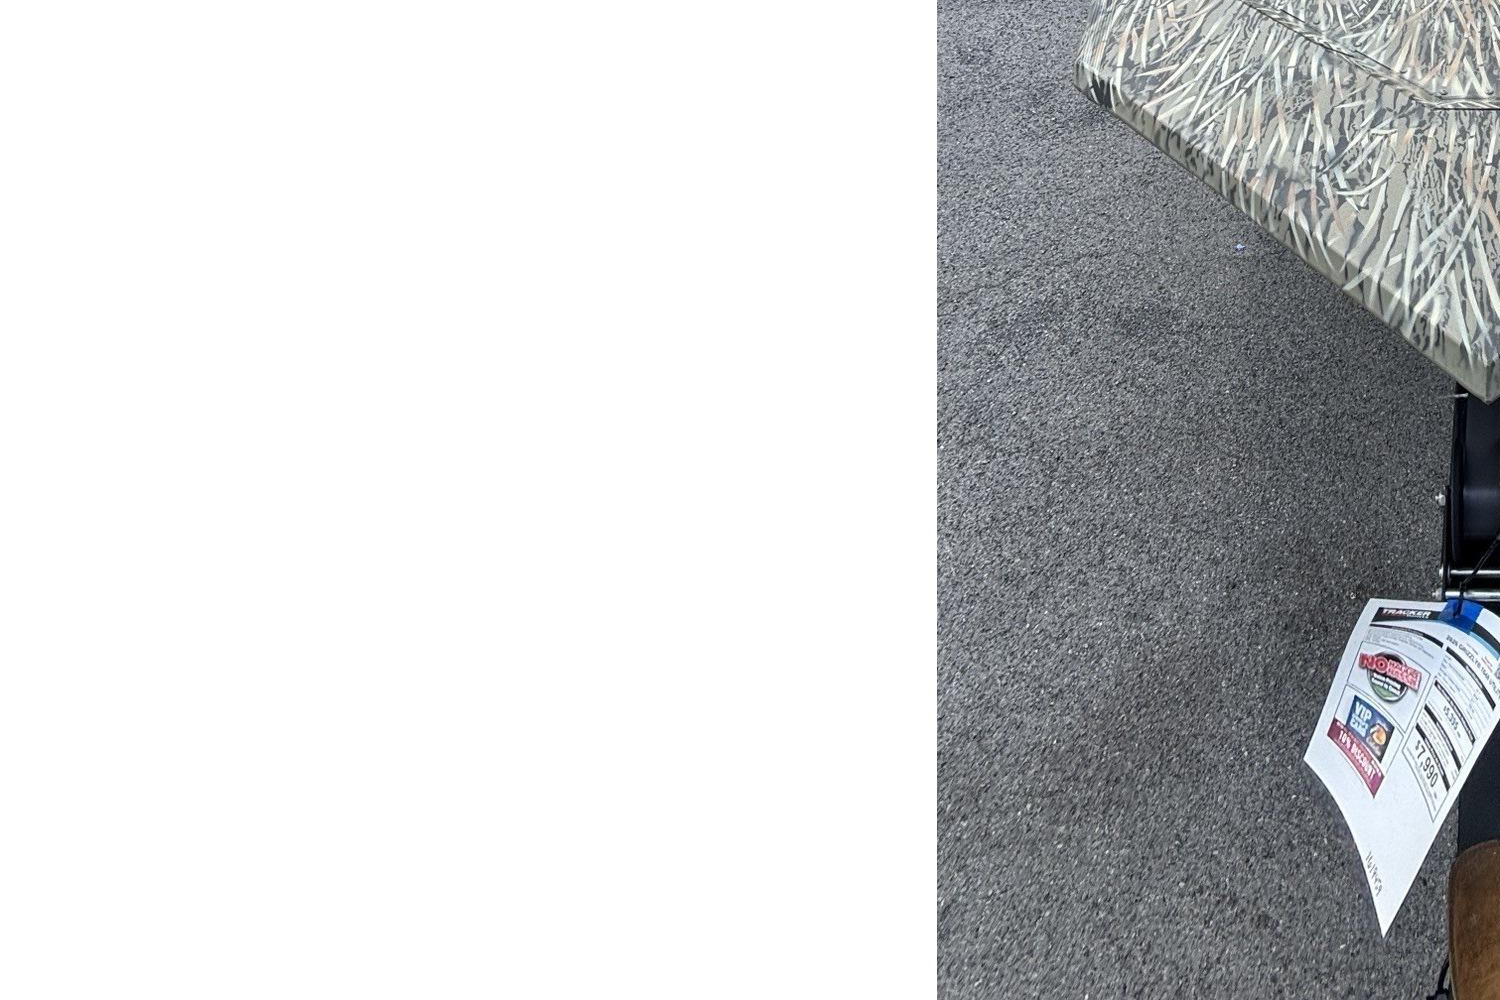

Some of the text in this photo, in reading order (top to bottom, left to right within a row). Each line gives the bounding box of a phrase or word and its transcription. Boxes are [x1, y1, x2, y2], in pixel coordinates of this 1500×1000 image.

[1381, 608, 1432, 619] TRACKER
[1359, 653, 1388, 673] NO
[1354, 701, 1373, 722] VIP
[1338, 729, 1351, 749] 10%
[1350, 742, 1376, 780] DISCOUNT
[1415, 739, 1439, 788] $7,990
